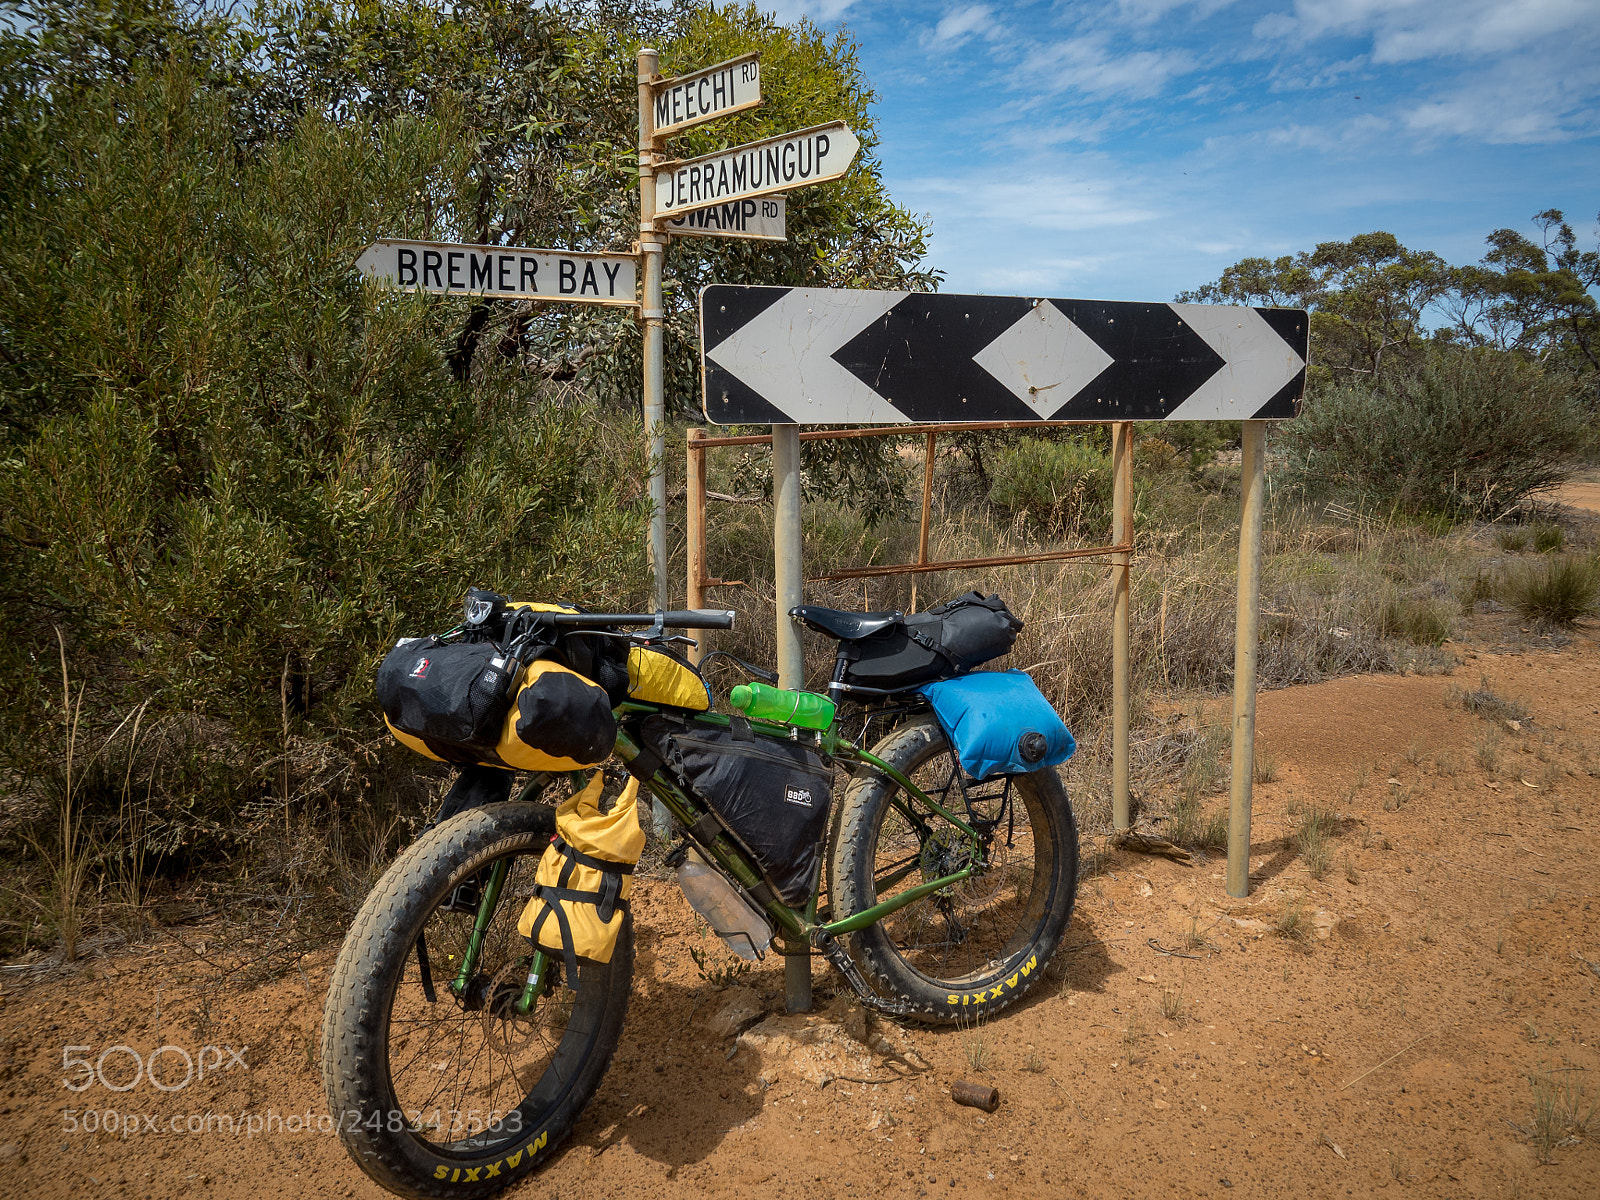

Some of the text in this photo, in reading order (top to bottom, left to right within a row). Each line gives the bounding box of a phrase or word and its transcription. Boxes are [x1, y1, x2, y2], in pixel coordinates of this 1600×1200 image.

[656, 62, 758, 129] MEECHI RD
[665, 134, 830, 208] JERRAMUNGUP
[762, 201, 778, 218] RD
[398, 248, 621, 296] BREMER BAY
[946, 954, 1038, 1006] MAXXIS
[433, 1130, 548, 1183] MAXXIS
